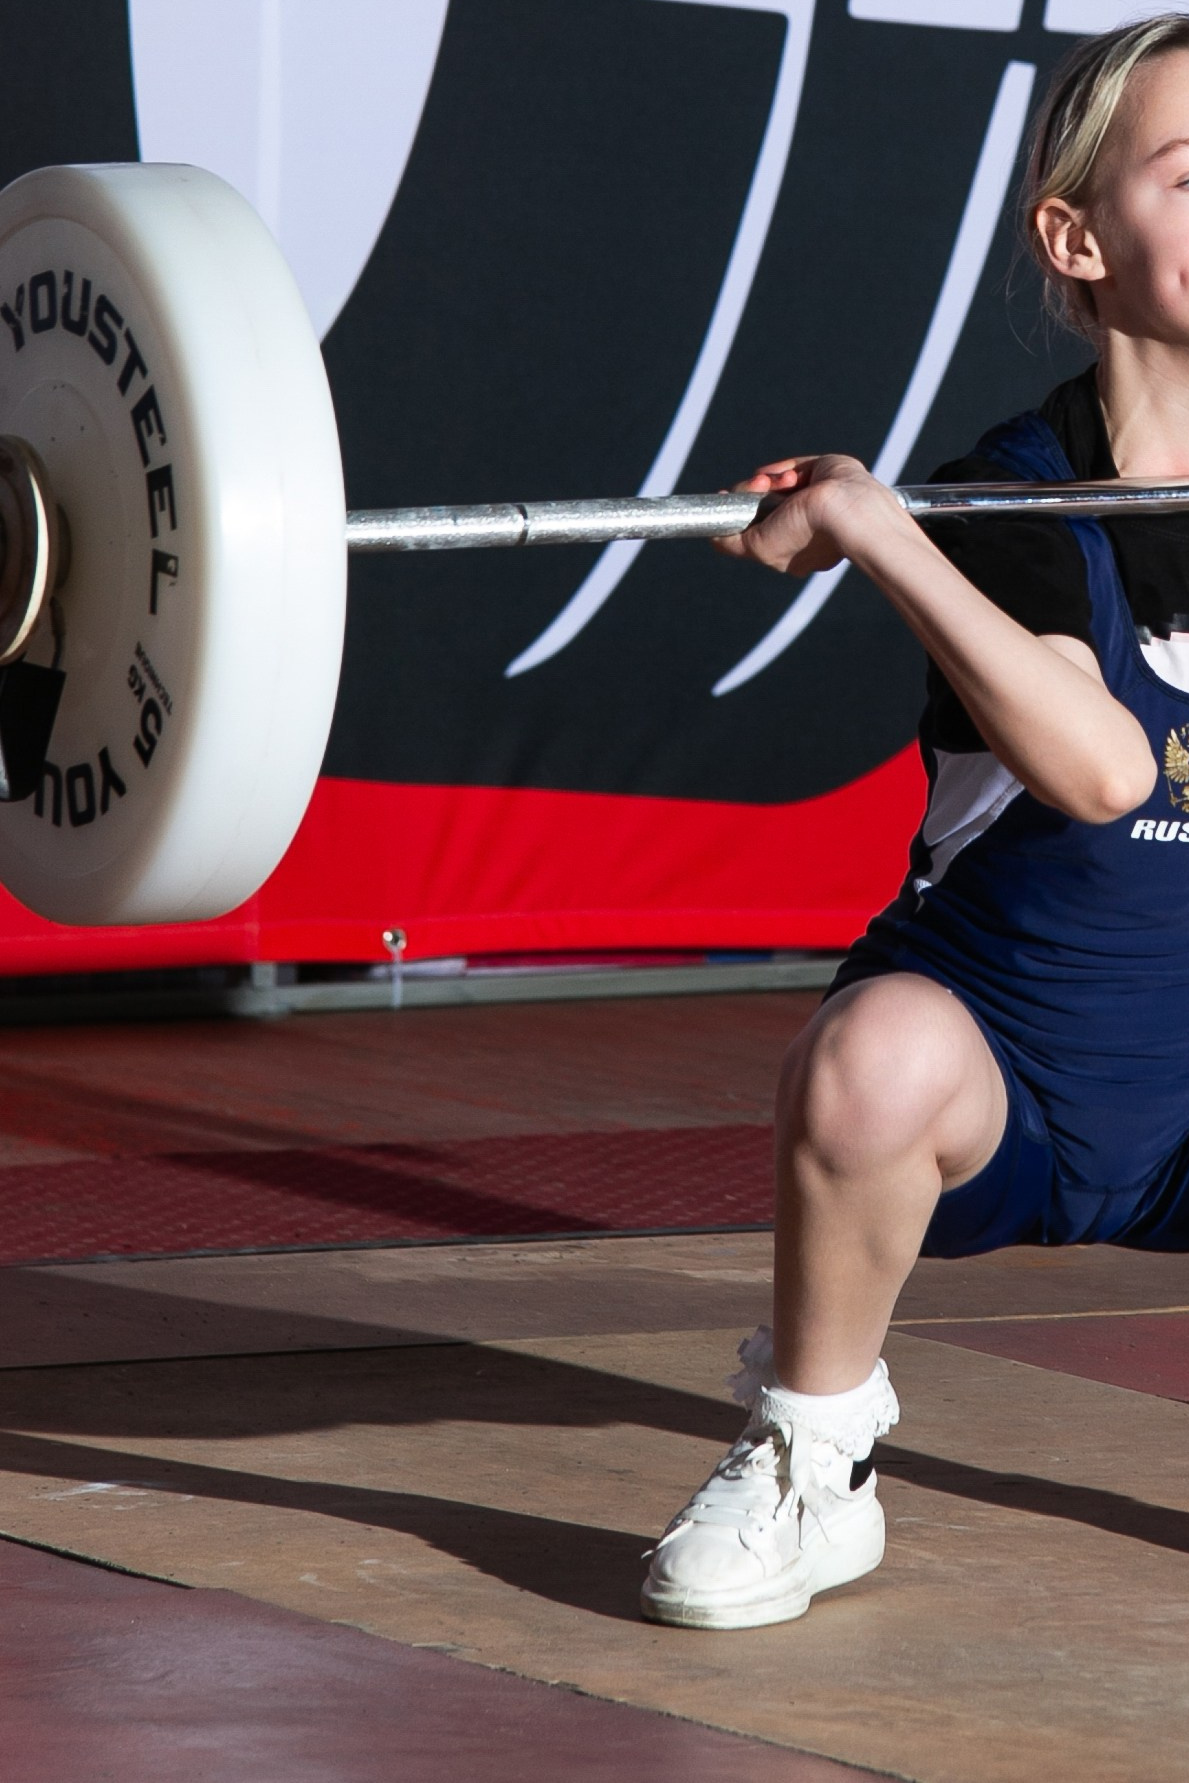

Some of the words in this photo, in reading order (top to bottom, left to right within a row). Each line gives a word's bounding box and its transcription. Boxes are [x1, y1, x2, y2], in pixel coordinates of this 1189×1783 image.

[0, 269, 180, 616] YOUSTEEL
[133, 697, 163, 768] 5
[34, 746, 127, 828] YOU
